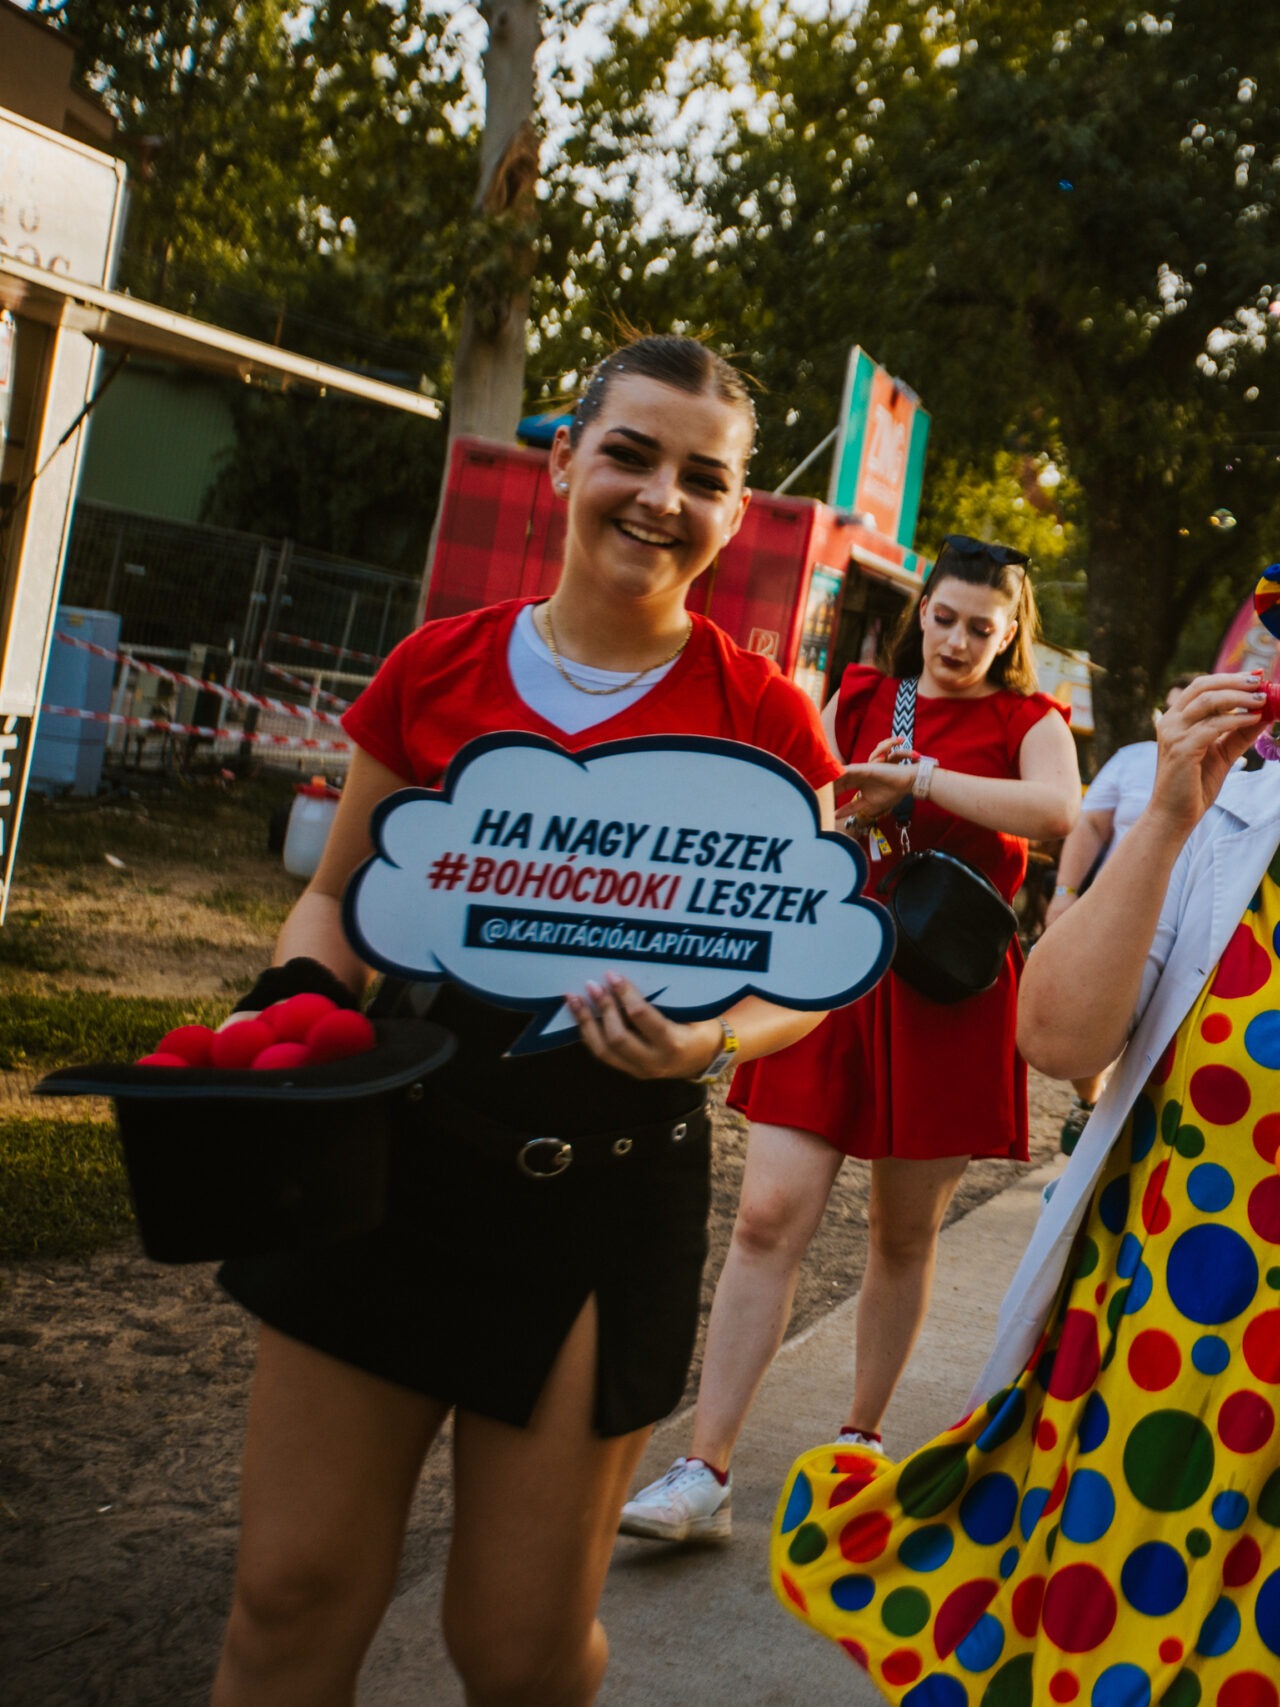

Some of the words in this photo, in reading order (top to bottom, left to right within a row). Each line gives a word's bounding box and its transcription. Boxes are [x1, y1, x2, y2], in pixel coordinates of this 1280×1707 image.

[471, 808, 534, 849] HA
[539, 815, 651, 859] NAGY
[649, 826, 793, 874] LESZEK
[426, 851, 682, 910] #BOHÓCDOKI
[685, 877, 828, 925] LESZEK
[480, 918, 759, 962] @KARITÁCIÓALAPÍTVÁNY
